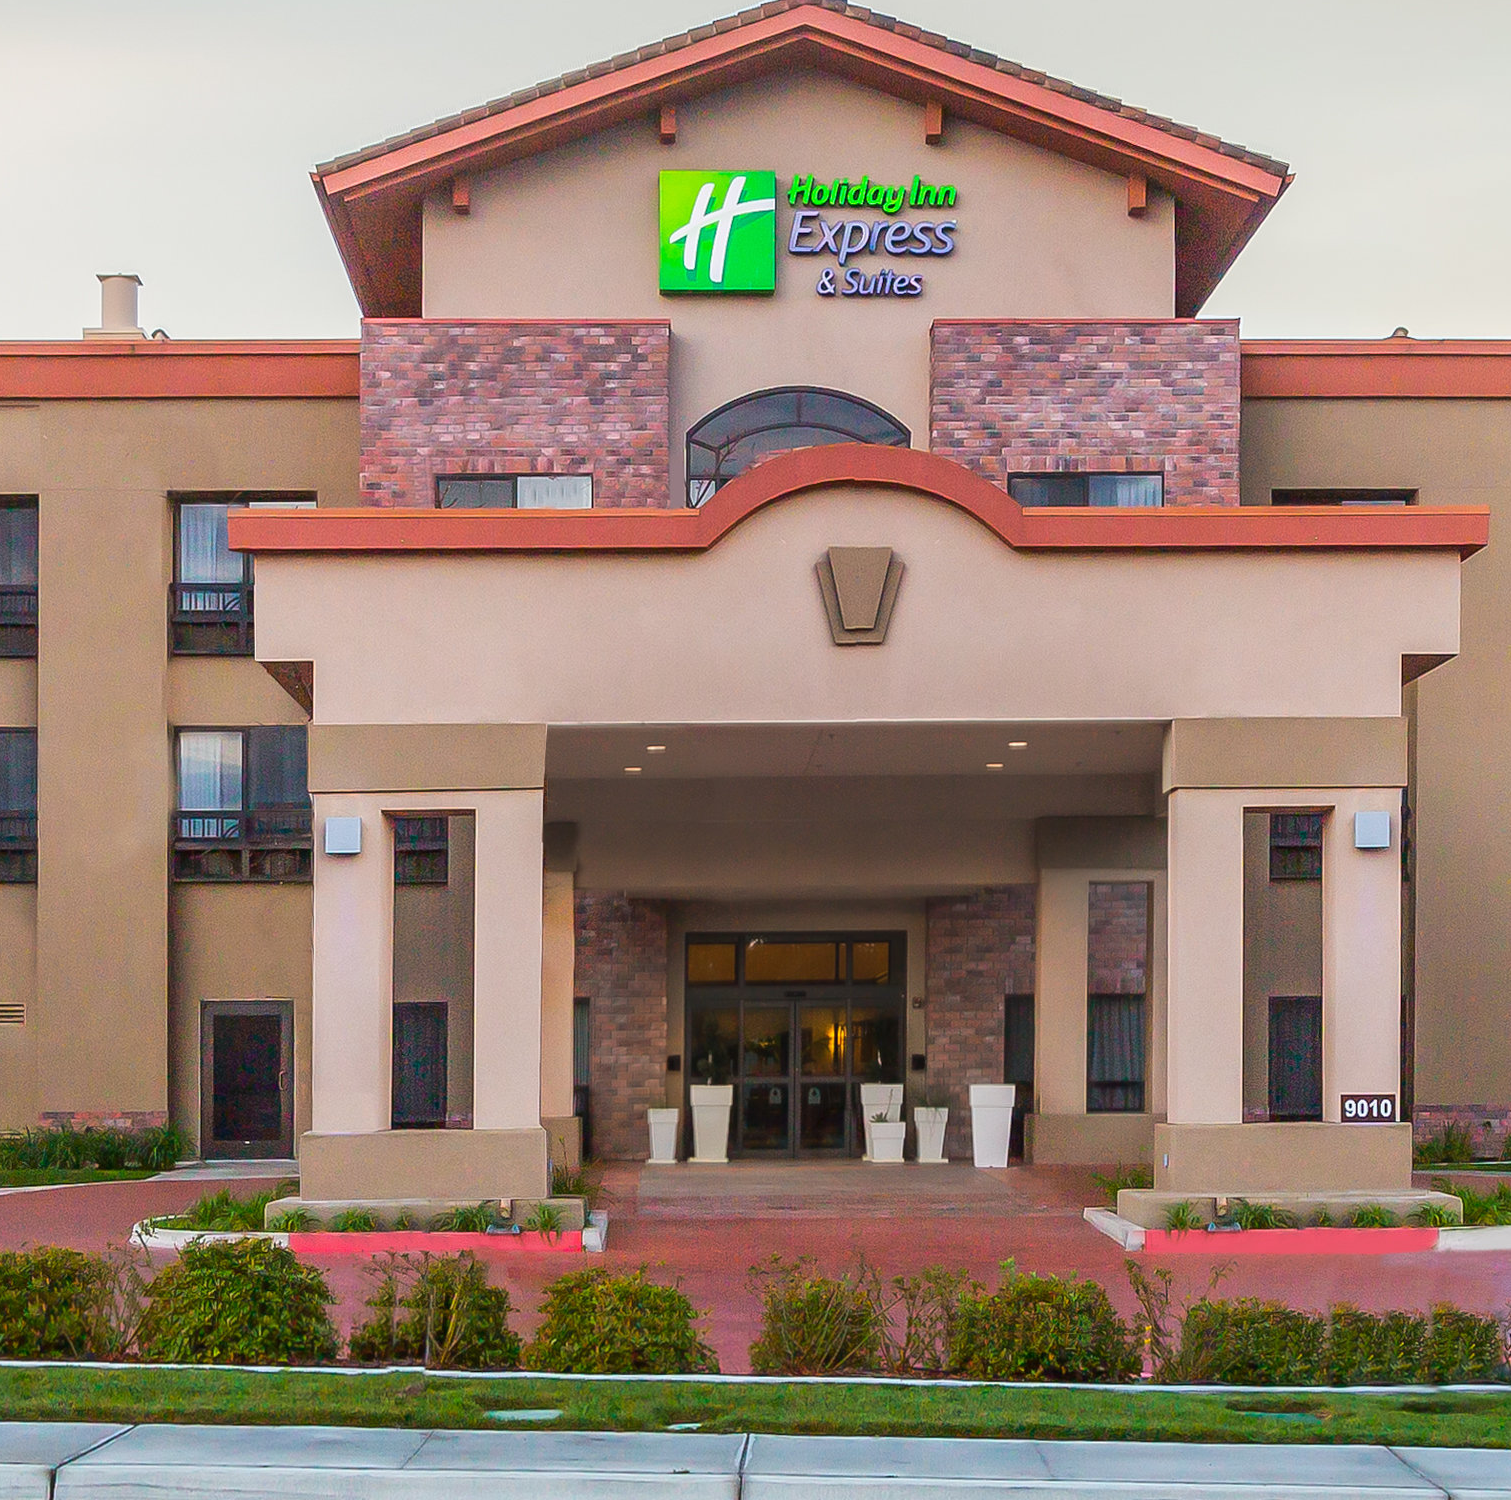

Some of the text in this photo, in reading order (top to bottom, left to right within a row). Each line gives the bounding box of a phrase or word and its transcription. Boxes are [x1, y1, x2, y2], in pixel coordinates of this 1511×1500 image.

[788, 174, 957, 214] Holiday Inn
[788, 210, 957, 266] Express
[816, 268, 923, 296] & Suites
[1344, 1099, 1392, 1117] 9010
